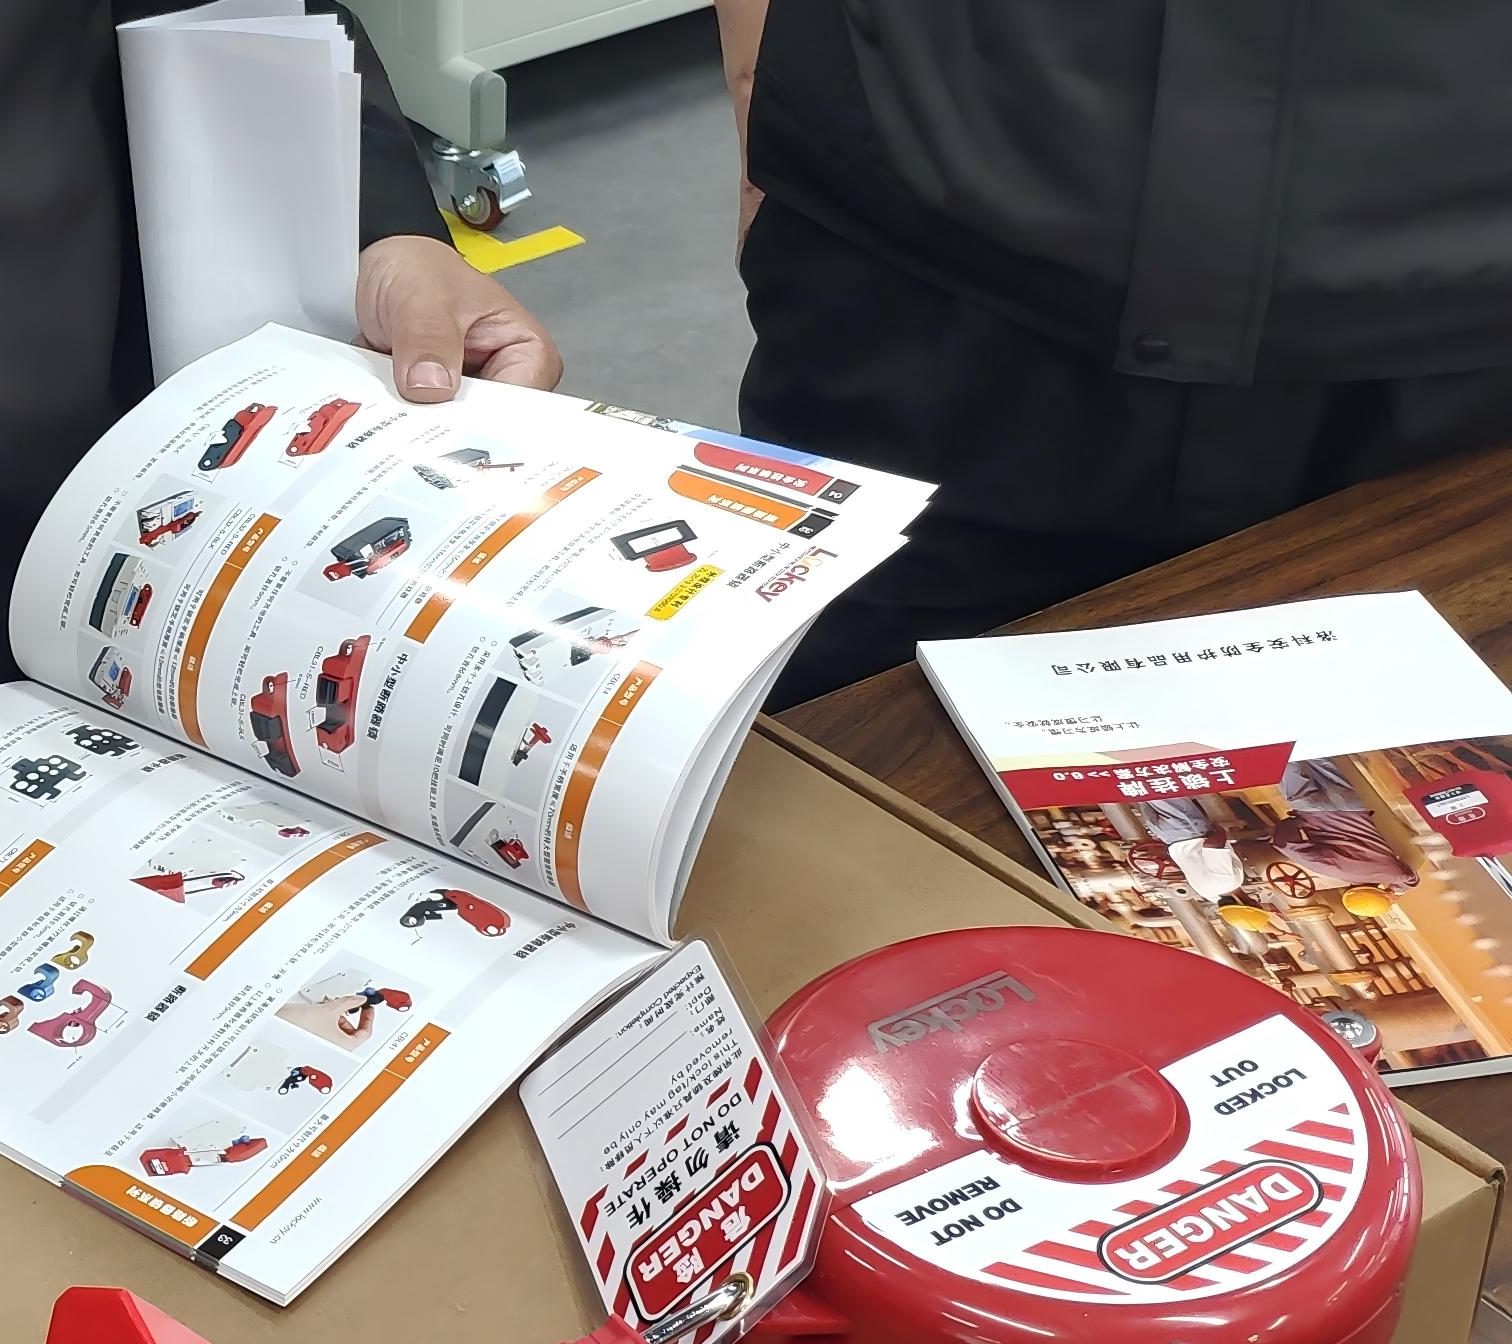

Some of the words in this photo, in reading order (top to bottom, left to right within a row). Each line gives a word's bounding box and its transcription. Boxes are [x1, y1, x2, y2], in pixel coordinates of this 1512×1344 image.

[1050, 628, 1337, 678] 洛科安全防护用品有限公司
[366, 653, 409, 740] 中小型断路器锁
[1115, 768, 1236, 798] 上锁挂牌
[662, 964, 700, 999] Expected
[143, 982, 186, 1025] 断路器锁
[689, 1006, 721, 1035] Name:
[865, 969, 1035, 1054] Lockey
[684, 1027, 733, 1072] removed
[713, 1038, 737, 1062] This
[667, 1059, 712, 1100] lock/tag
[671, 1070, 684, 1085] by
[1209, 1058, 1259, 1088] OUT
[1214, 1067, 1307, 1115] LOCKED
[643, 1098, 666, 1120] may
[716, 1091, 741, 1118] DO
[602, 1140, 618, 1155] be
[619, 1119, 642, 1143] only
[681, 1115, 714, 1151] NOT
[603, 1147, 678, 1216] OPERATE
[623, 1119, 742, 1231] 请勿操作
[894, 1175, 1000, 1226] REMOVE
[982, 1197, 1022, 1221] DO
[216, 1233, 232, 1245] 33
[636, 1161, 764, 1282] DANGER
[930, 1214, 983, 1246] NOT
[1113, 1172, 1303, 1271] DANGER
[671, 1203, 753, 1286] 危险
